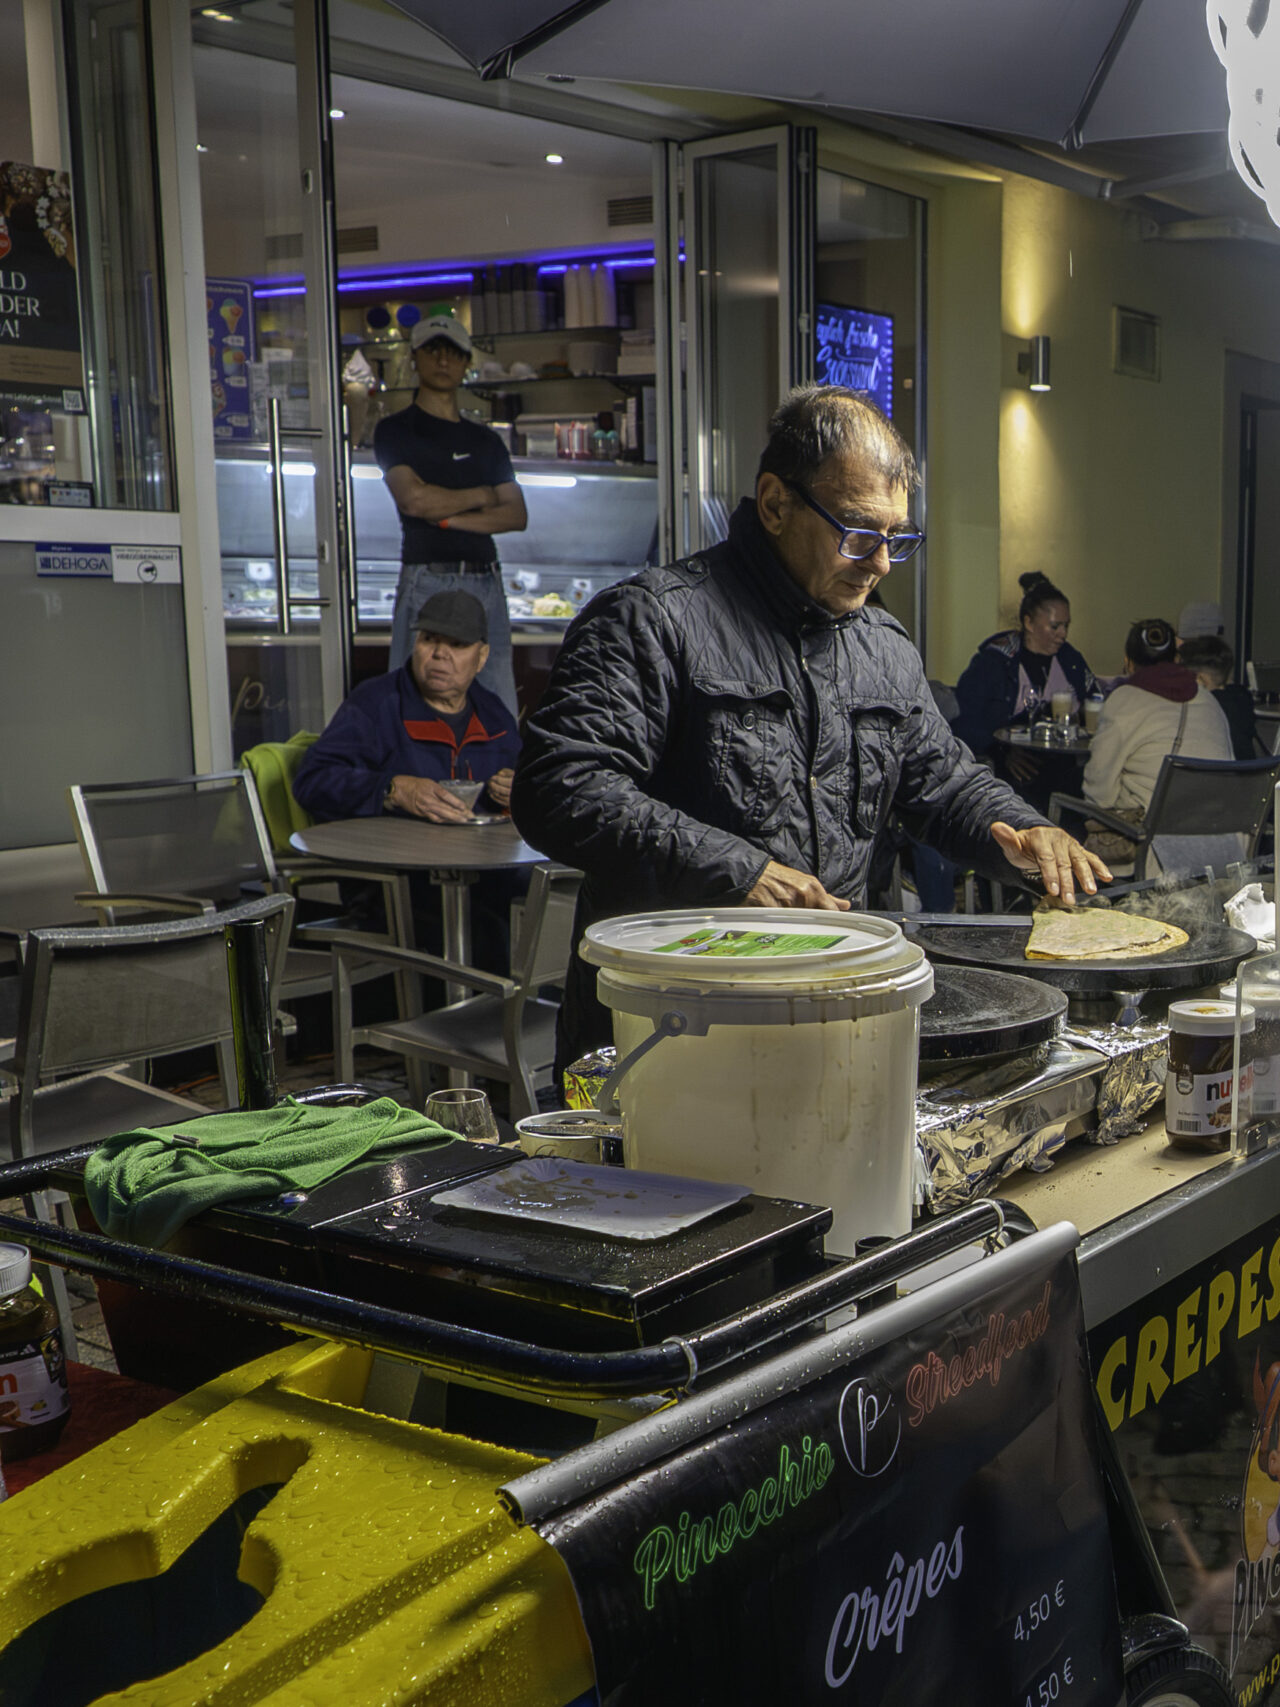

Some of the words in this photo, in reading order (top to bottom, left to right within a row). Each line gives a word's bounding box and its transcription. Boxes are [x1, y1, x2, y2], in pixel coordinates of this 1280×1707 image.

[0, 319, 21, 339] A!
[52, 557, 109, 571] DEHOGA
[633, 1435, 835, 1610] Pinocchio
[825, 1525, 965, 1689] Crêpes
[1013, 1593, 1051, 1642] 4,50
[1054, 1578, 1067, 1608] €
[1025, 1672, 1060, 1707] 50
[1063, 1656, 1075, 1686] €
